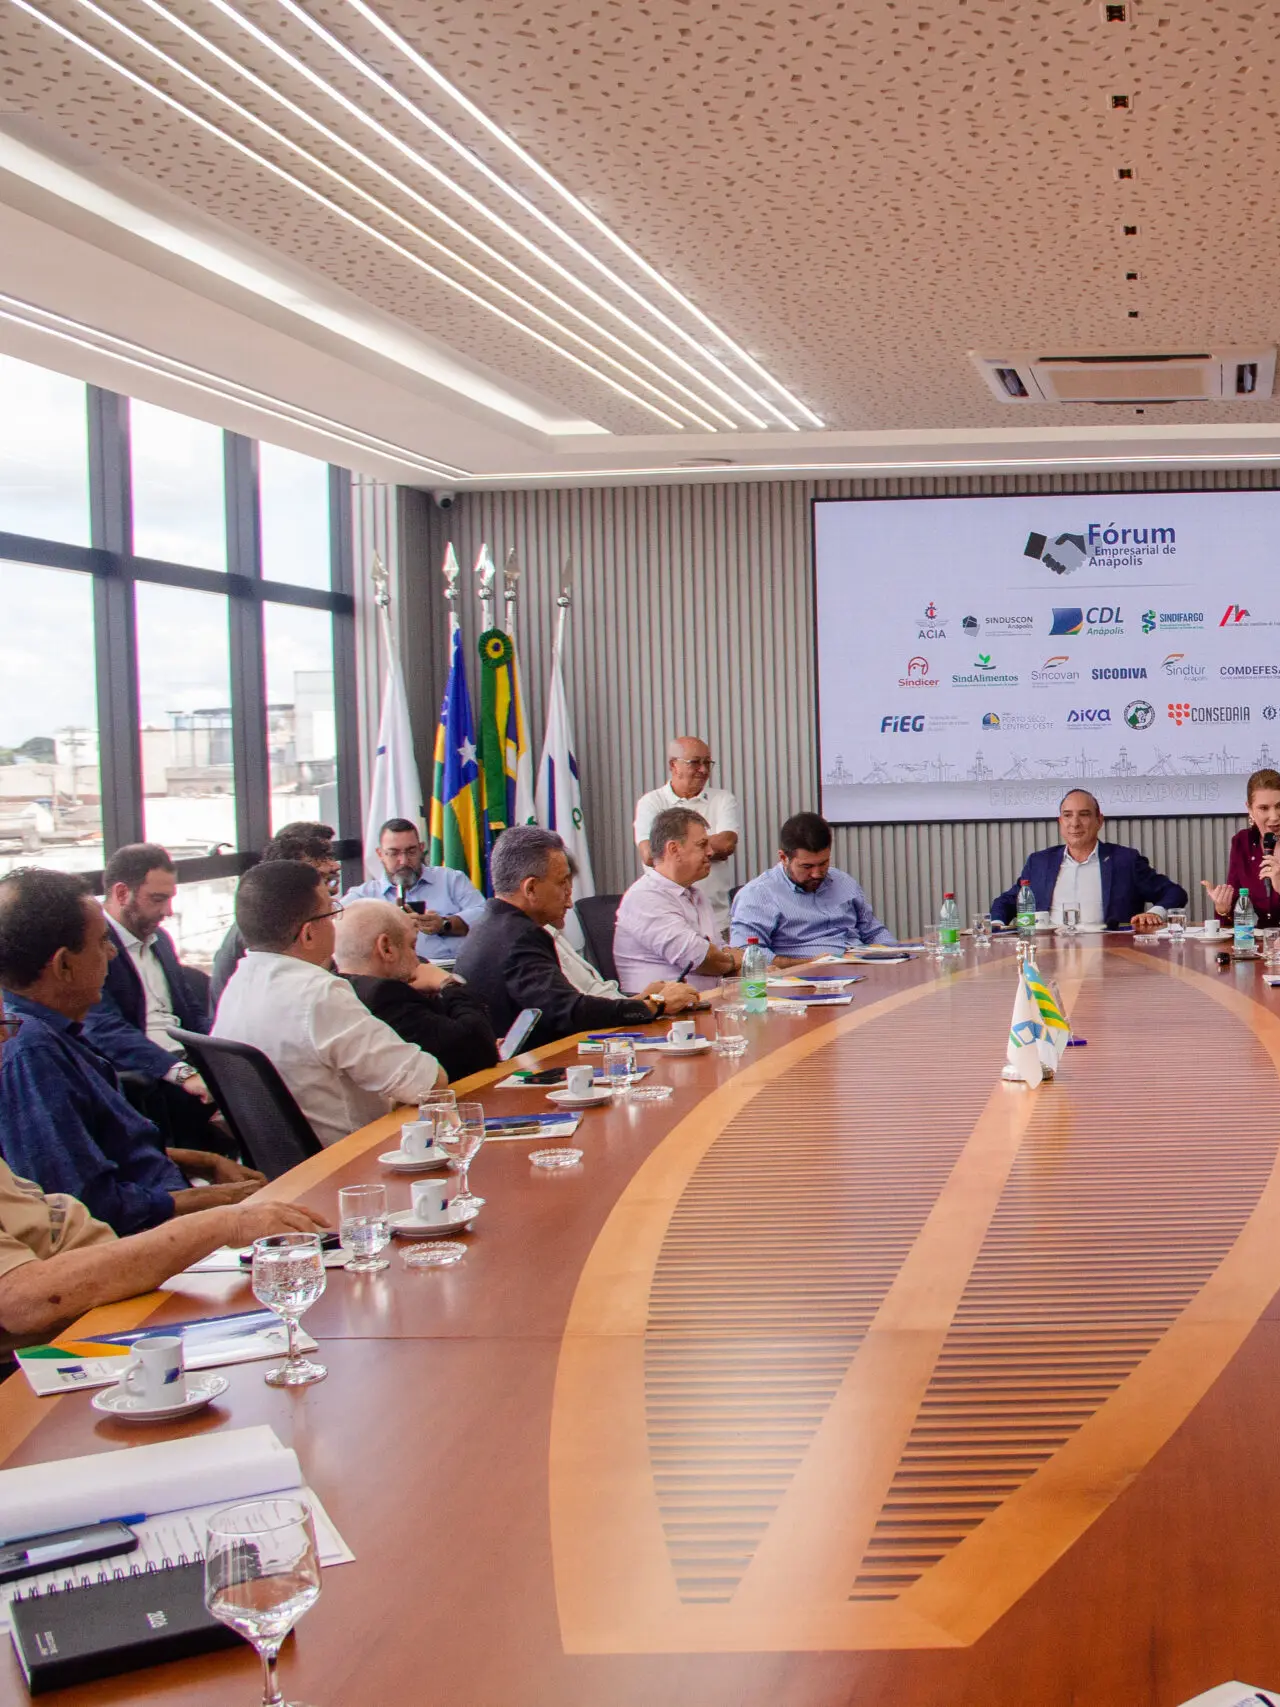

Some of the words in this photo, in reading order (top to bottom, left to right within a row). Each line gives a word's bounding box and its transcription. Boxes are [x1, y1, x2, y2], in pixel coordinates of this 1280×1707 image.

[1088, 522, 1176, 546] Fórum
[1095, 545, 1159, 557] Empresarial
[1163, 545, 1176, 555] de
[1089, 556, 1143, 568] Anápolis
[985, 616, 1033, 624] SINDUSCON
[1086, 606, 1124, 624] CDL
[1159, 612, 1204, 622] SINDIFARGO
[918, 630, 946, 639] ACIA
[1086, 627, 1124, 636] Anápolis
[1091, 668, 1147, 680] SICODIVA
[1165, 664, 1206, 675] Sindtur
[952, 674, 1019, 683] SindAlimentos
[1031, 670, 1080, 681] Sincovan
[898, 678, 940, 686] Sindicer
